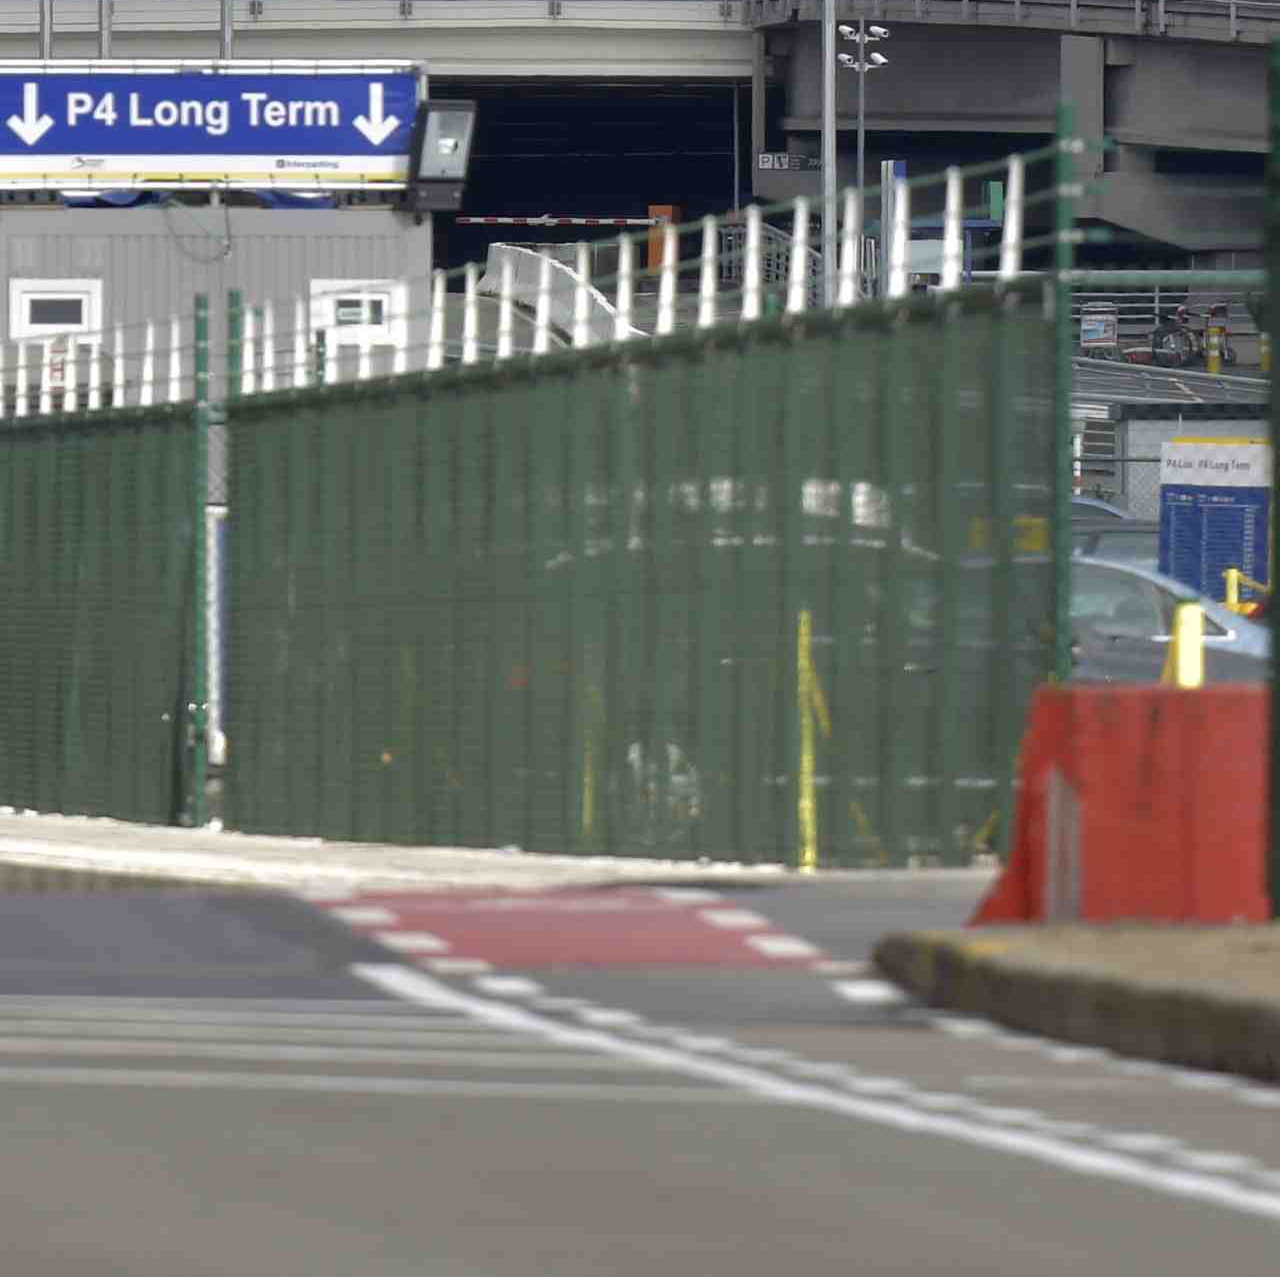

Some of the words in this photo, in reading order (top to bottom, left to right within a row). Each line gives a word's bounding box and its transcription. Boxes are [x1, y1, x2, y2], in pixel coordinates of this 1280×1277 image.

[66, 92, 118, 126] P4
[129, 92, 229, 135] Long
[242, 92, 339, 127] Term
